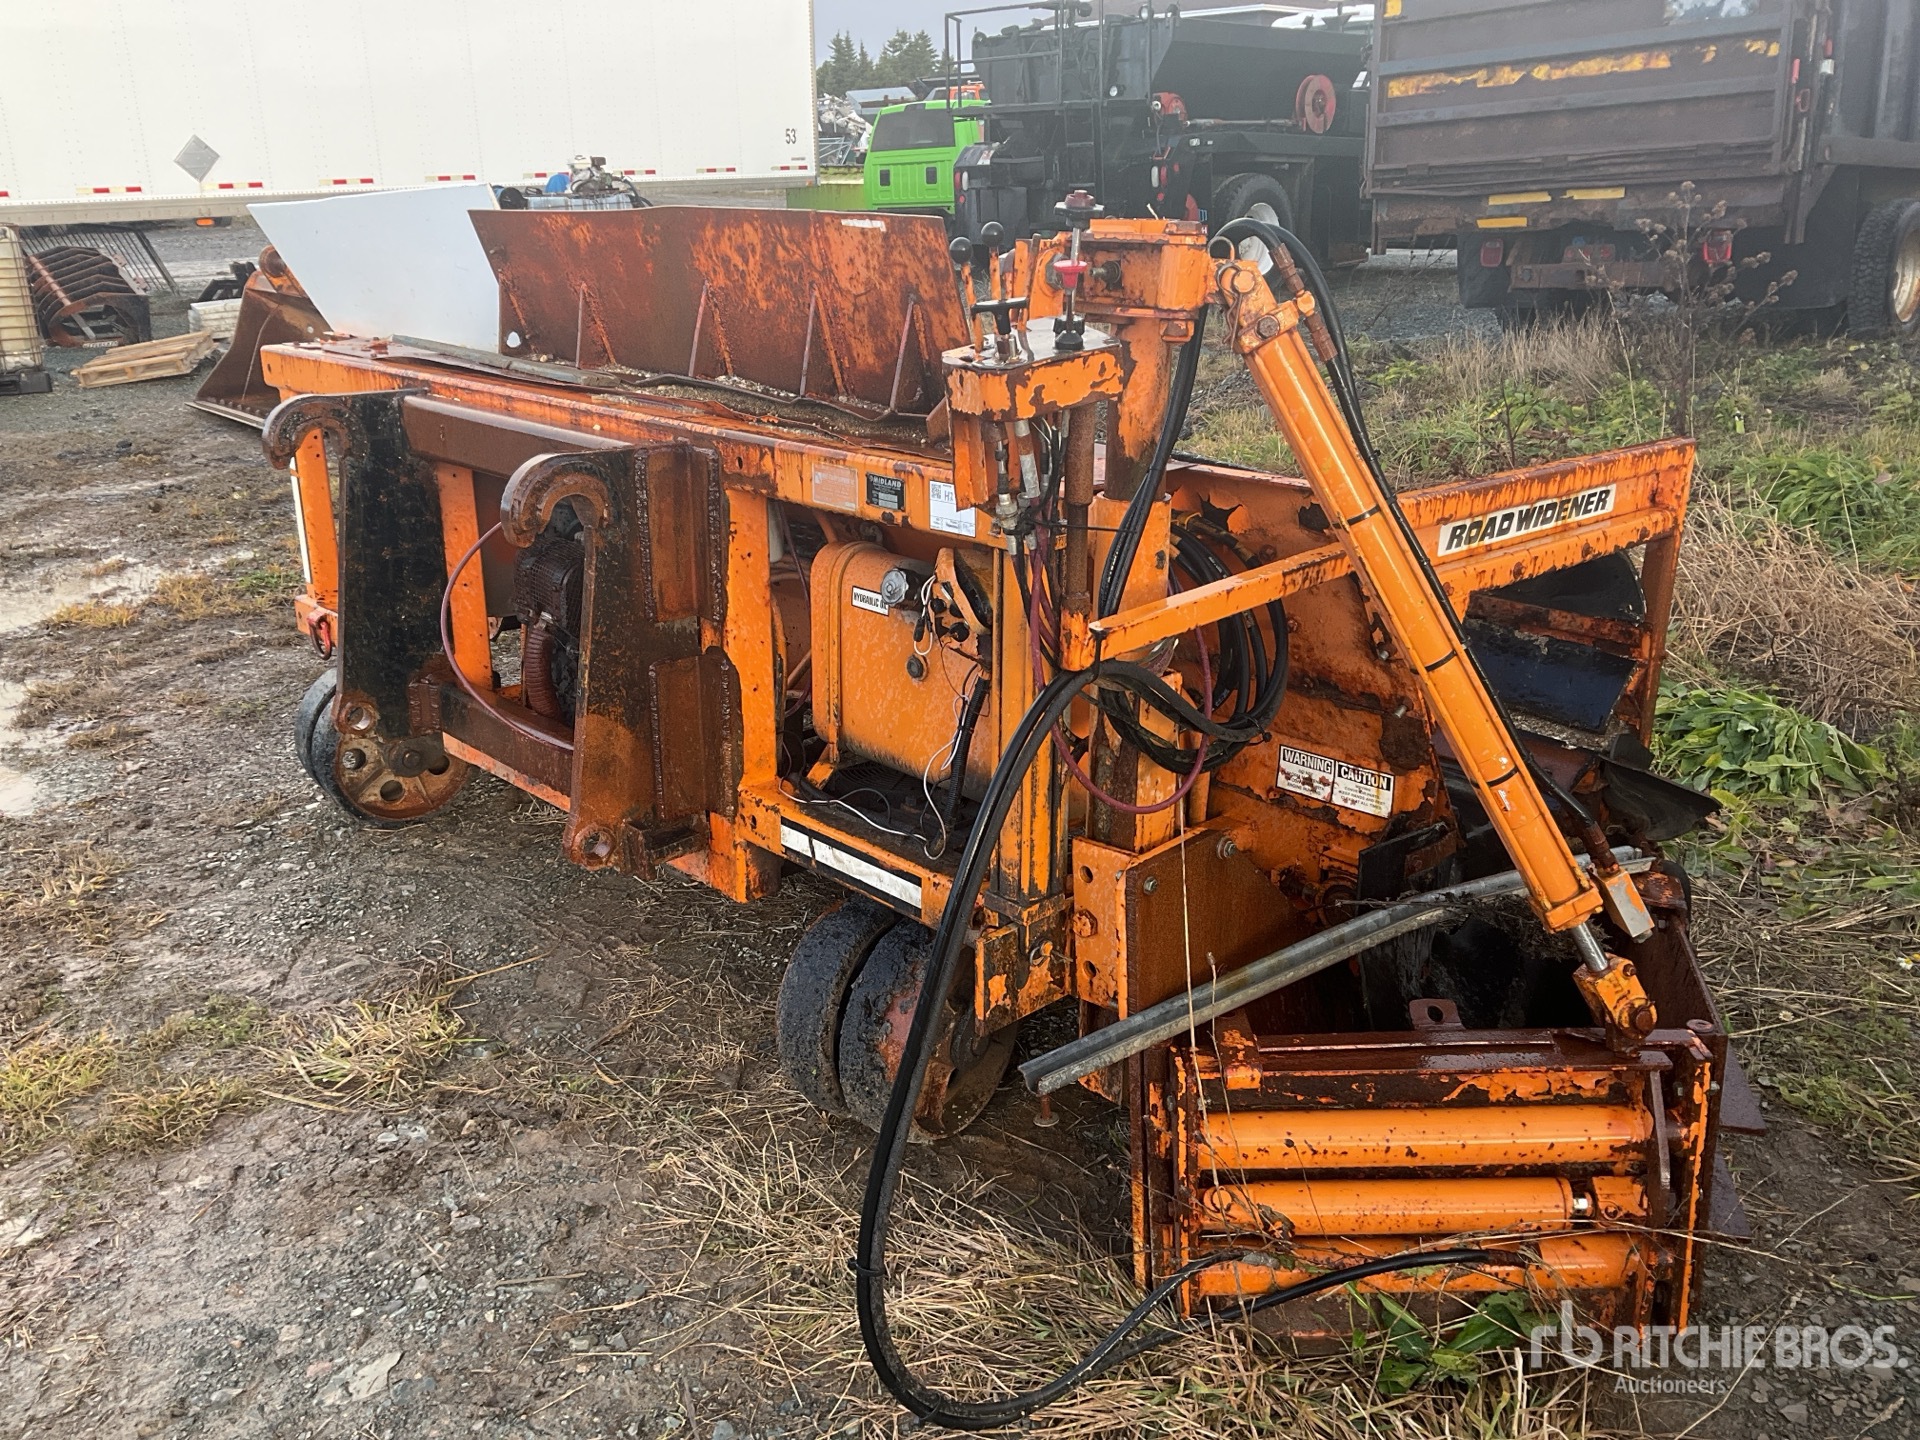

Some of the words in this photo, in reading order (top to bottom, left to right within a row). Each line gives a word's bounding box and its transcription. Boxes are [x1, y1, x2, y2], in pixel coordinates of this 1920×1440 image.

[873, 476, 902, 488] MIDLAND
[853, 591, 879, 608] HYDRAULIC
[1284, 749, 1332, 774] WARNING
[1340, 766, 1388, 790] CAUTION
